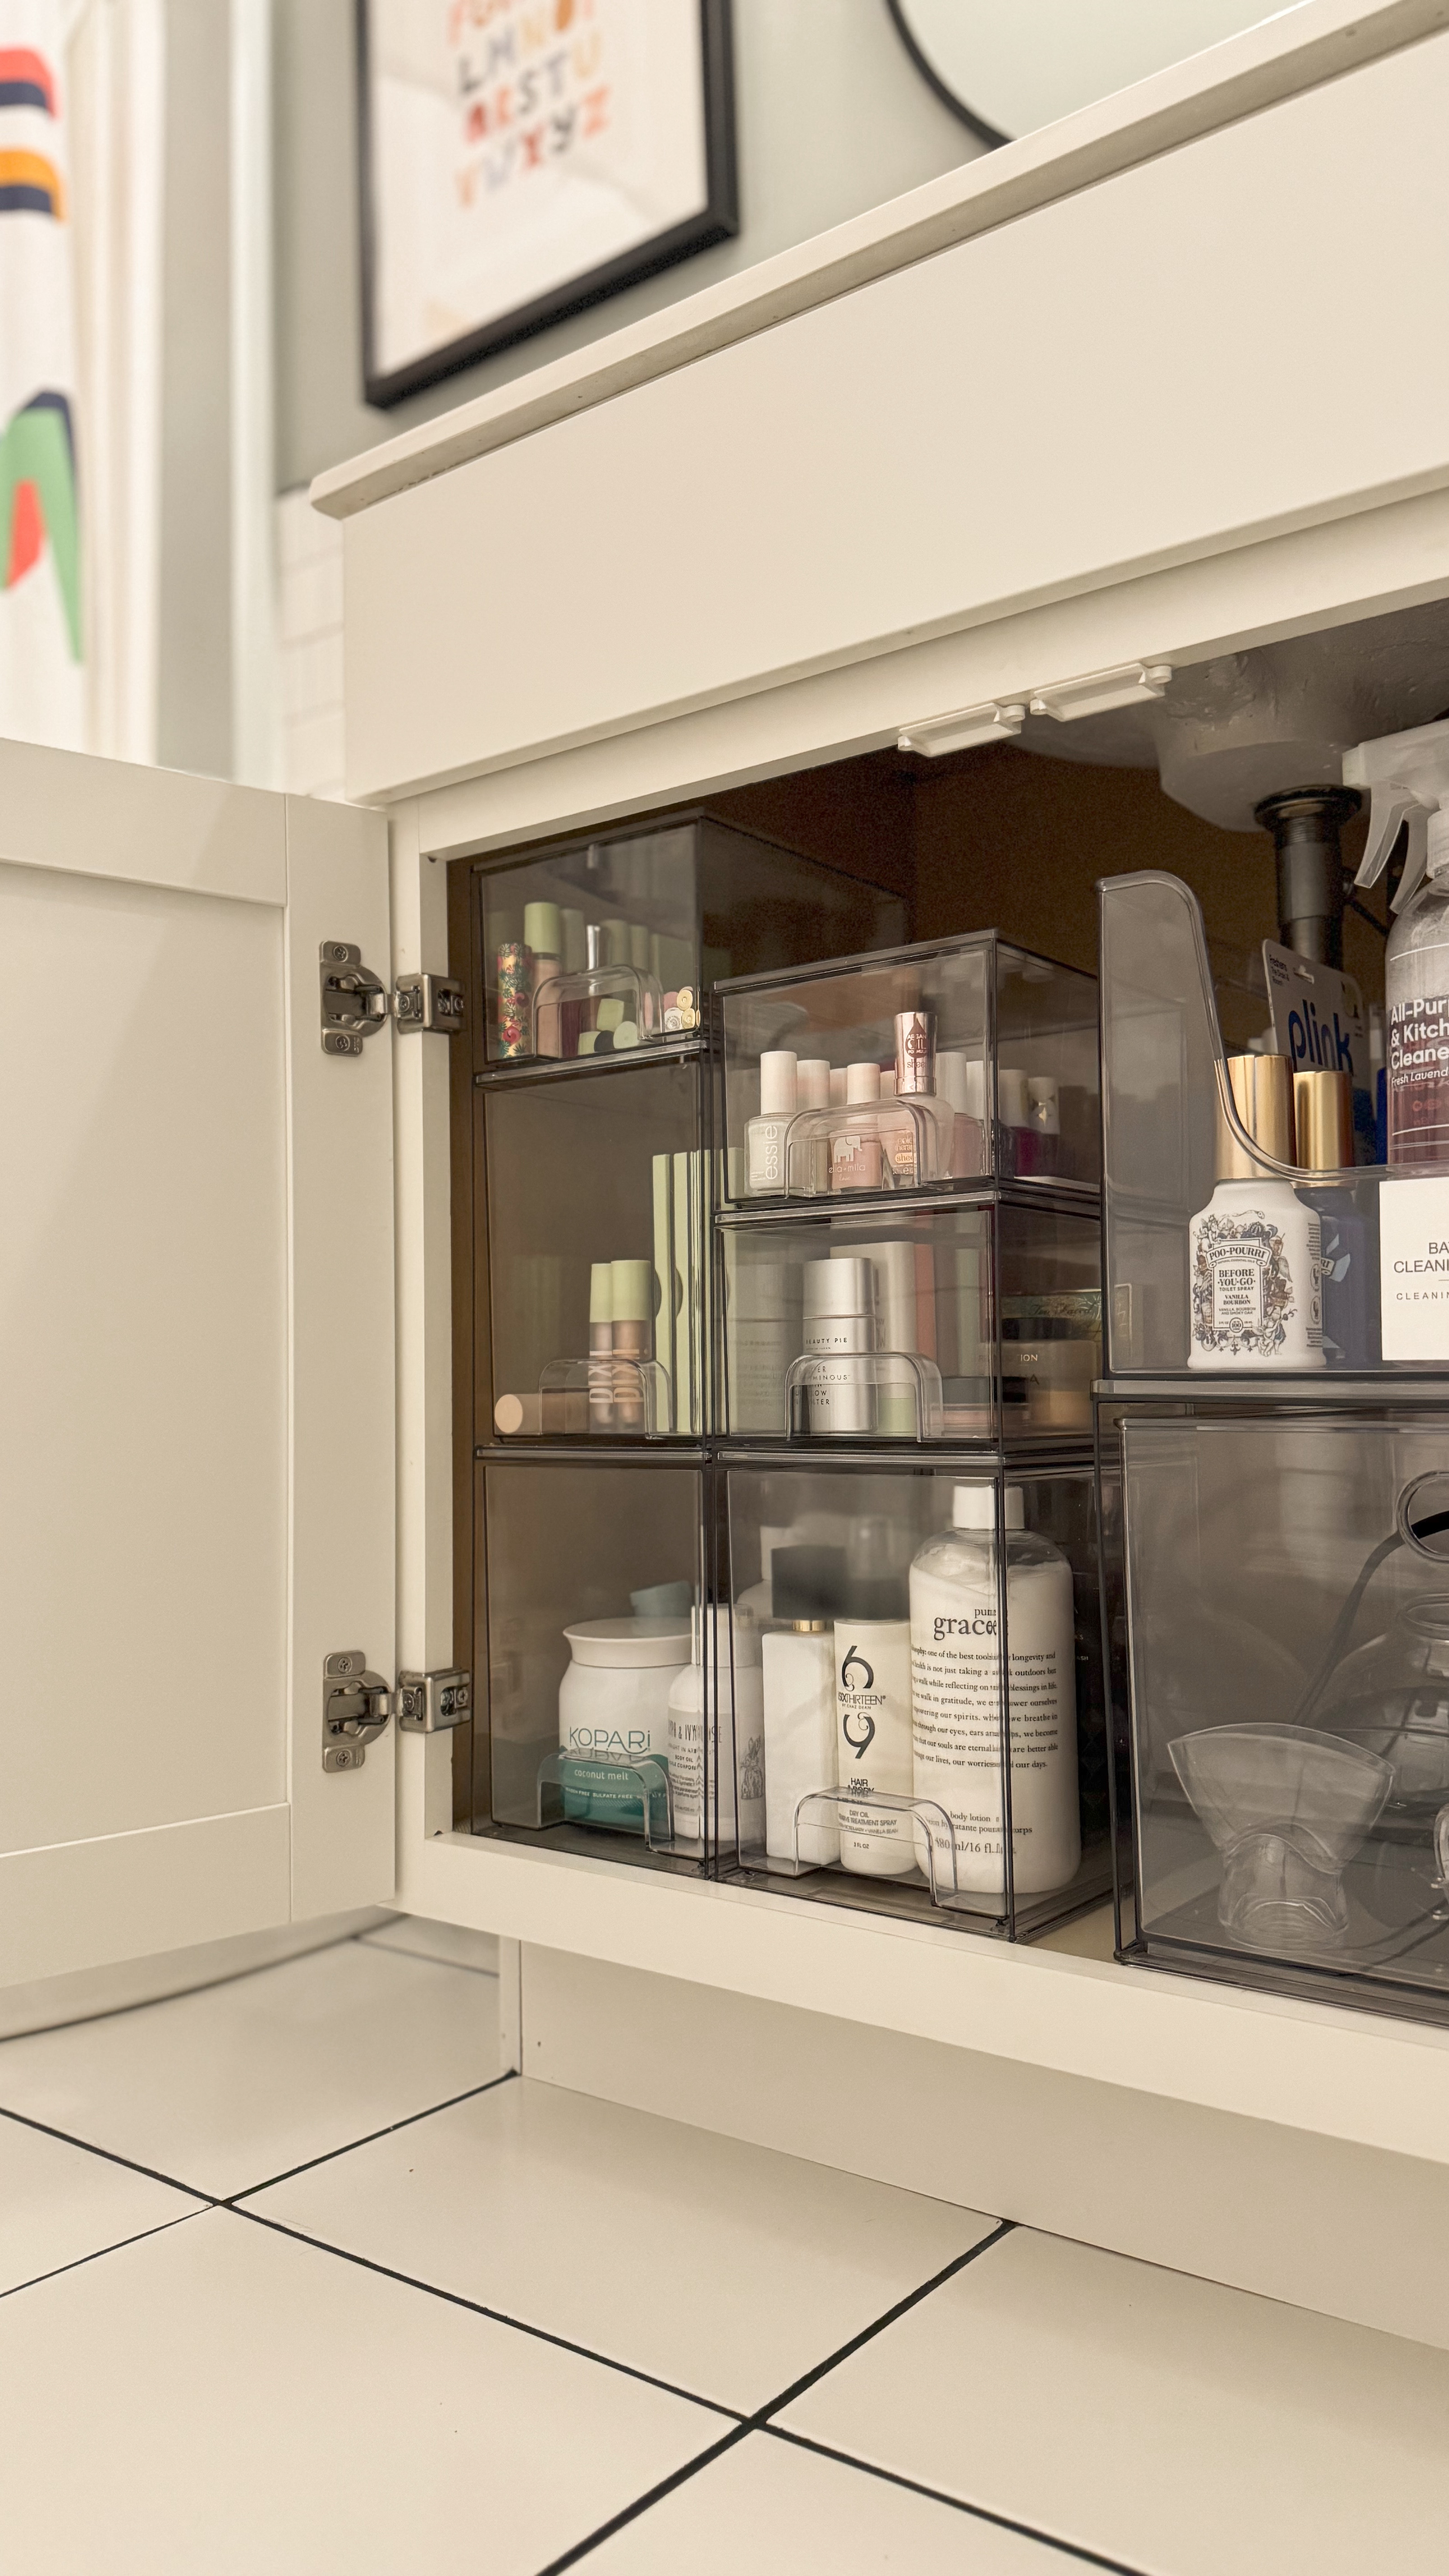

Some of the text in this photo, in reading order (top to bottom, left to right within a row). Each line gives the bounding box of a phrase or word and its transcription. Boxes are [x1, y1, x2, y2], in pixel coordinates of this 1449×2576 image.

[1391, 998, 1449, 1025] All-Pur
[1289, 999, 1354, 1076] plink
[1391, 1029, 1400, 1047] &
[1410, 1065, 1449, 1082] Lavend
[766, 1126, 778, 1180] essie
[1428, 1242, 1449, 1254] BA
[1219, 1269, 1255, 1277] BEFORE
[1012, 1653, 1044, 1663] longevity
[1045, 1651, 1055, 1659] and
[945, 1666, 956, 1674] just
[959, 1667, 982, 1677] taking
[929, 1679, 944, 1688] while
[945, 1681, 978, 1692] reflecting
[941, 1697, 974, 1706] gratitude,
[1030, 1698, 1057, 1706] ourselves
[954, 1713, 981, 1721] spirits.
[918, 1722, 936, 1733] through
[935, 1755, 950, 1765] lives,
[1032, 1761, 1047, 1769] days.
[574, 1769, 628, 1780] coconut melt
[851, 1777, 868, 1787] HAIR
[950, 1811, 990, 1822] body lotion
